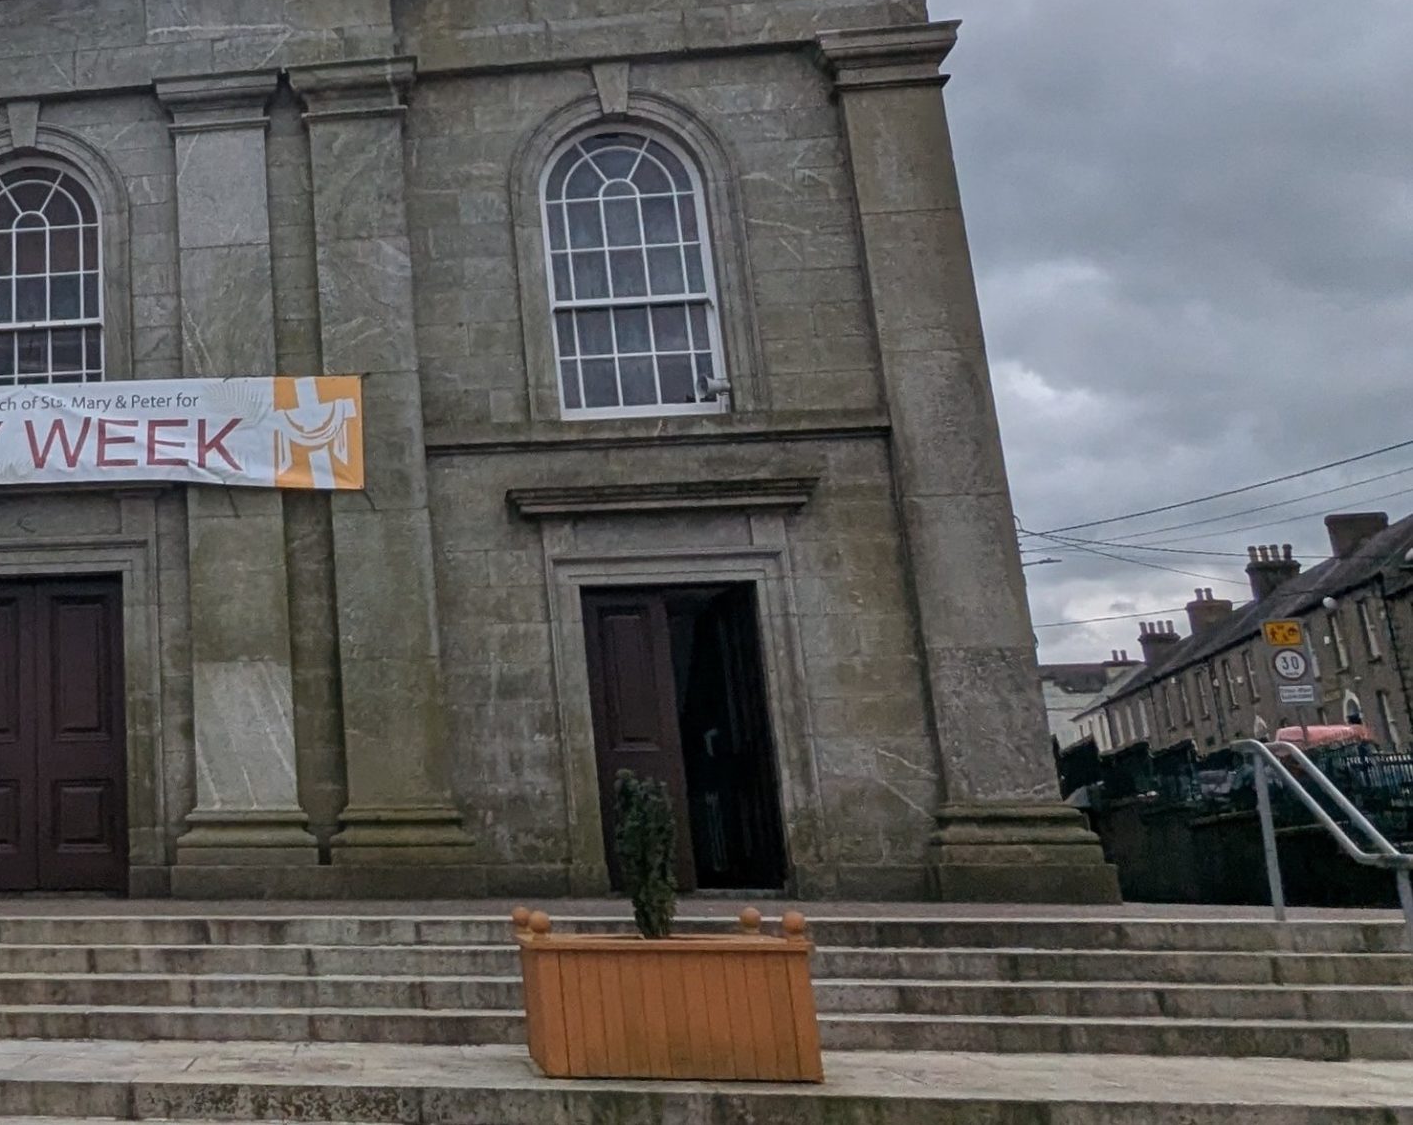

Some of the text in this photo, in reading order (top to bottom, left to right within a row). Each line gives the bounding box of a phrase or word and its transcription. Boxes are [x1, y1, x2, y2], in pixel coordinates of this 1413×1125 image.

[21, 396, 38, 410] of
[41, 395, 67, 410] Sts.
[71, 396, 112, 413] Mary
[115, 394, 127, 409] &
[131, 394, 173, 409] Peter
[176, 392, 200, 408] for
[24, 416, 243, 472] WEEK
[1281, 655, 1299, 670] 30
